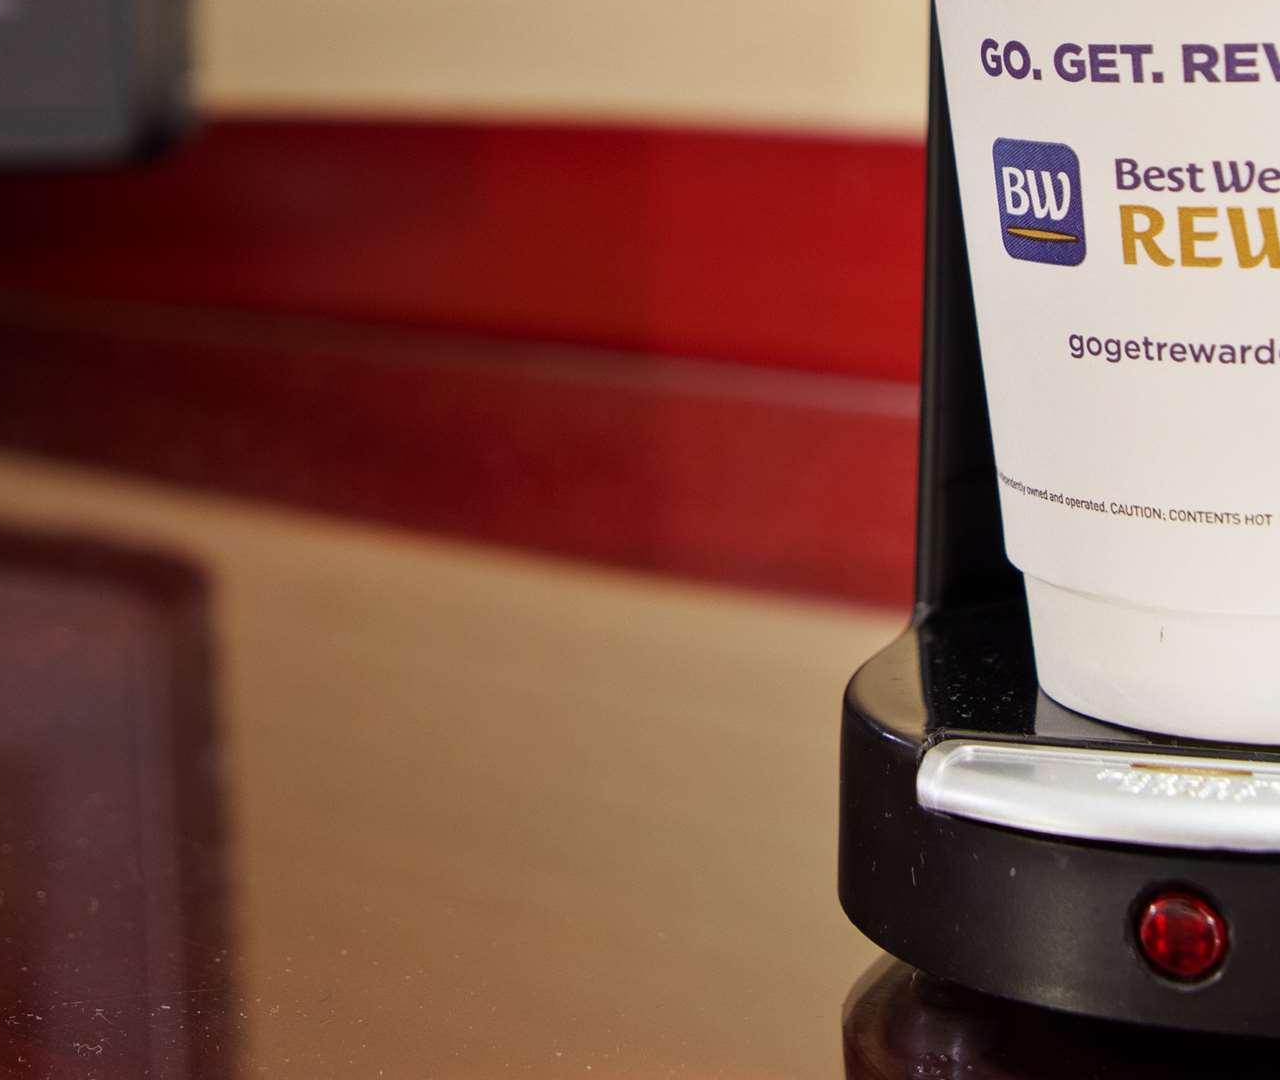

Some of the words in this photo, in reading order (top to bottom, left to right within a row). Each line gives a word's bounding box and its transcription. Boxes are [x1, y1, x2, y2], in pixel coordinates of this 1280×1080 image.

[980, 38, 1043, 81] GO.
[1053, 42, 1164, 84] GET.
[1001, 166, 1071, 220] BW
[1114, 157, 1204, 193] Best
[1026, 486, 1048, 500] owned
[1049, 492, 1064, 504] and
[1065, 496, 1108, 514] operated.
[1110, 502, 1167, 521] CAUTION:
[1168, 508, 1242, 525] CONTENTS
[1244, 513, 1273, 527] HOT
